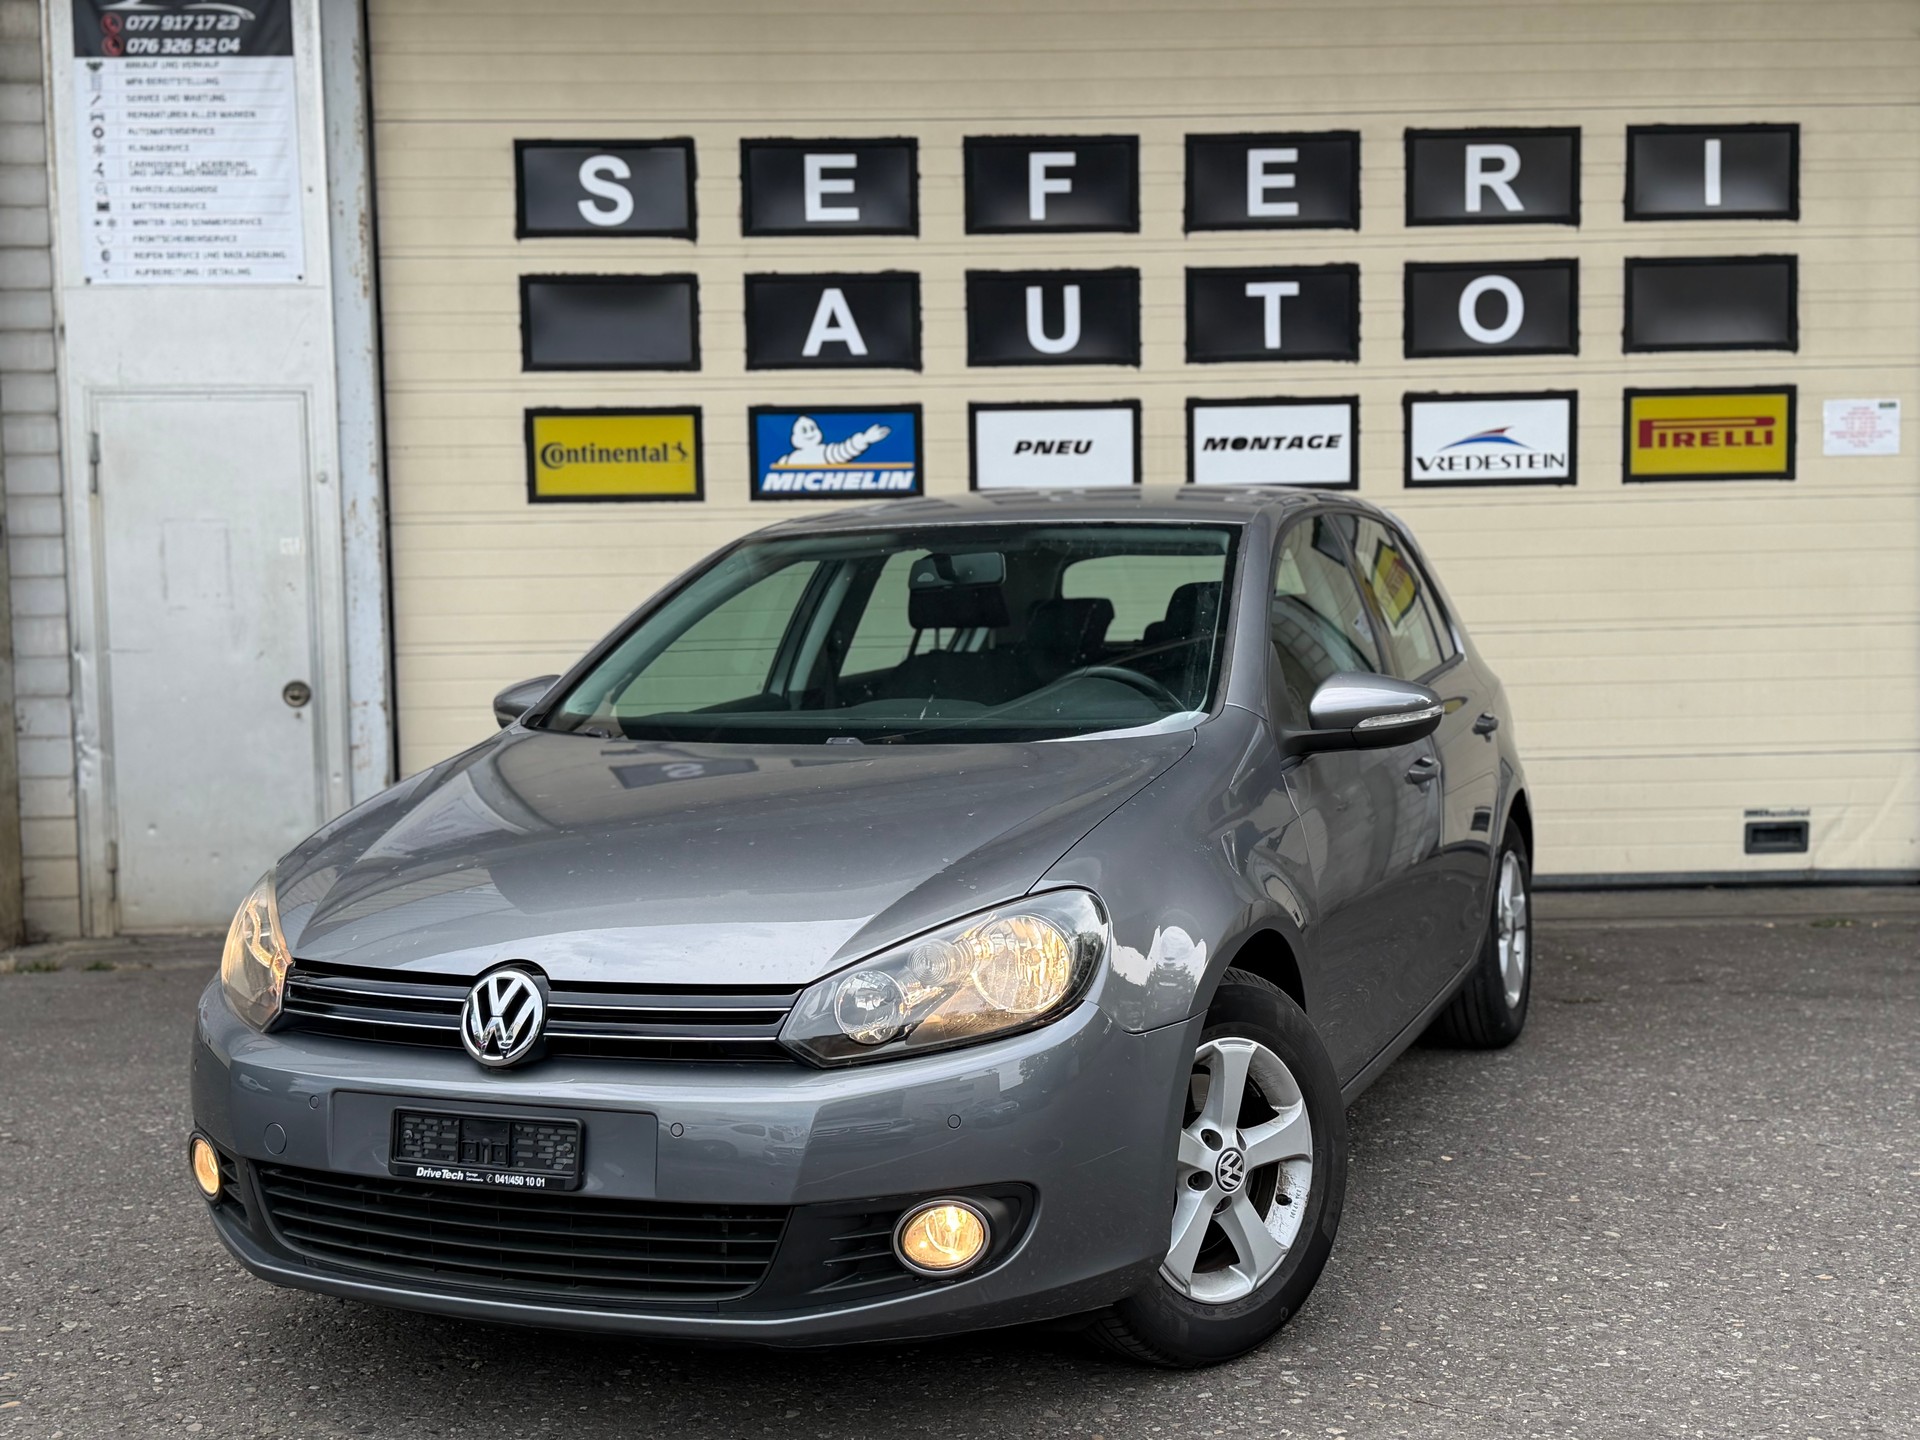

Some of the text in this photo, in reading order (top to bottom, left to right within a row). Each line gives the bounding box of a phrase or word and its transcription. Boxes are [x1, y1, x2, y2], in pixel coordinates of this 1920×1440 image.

[125, 15, 240, 31] 077 917 17 23
[126, 37, 240, 54] 076 326 52 04
[1638, 415, 1776, 450] PIRELLI
[1012, 439, 1094, 456] PNEU
[1201, 433, 1343, 452] MONTAGE
[540, 442, 669, 470] Continental
[1414, 451, 1566, 473] VREDESTEIN
[761, 470, 915, 492] MICHELIN
[416, 1167, 464, 1181] DriveTech
[495, 1174, 546, 1188] 041/450 10 01
